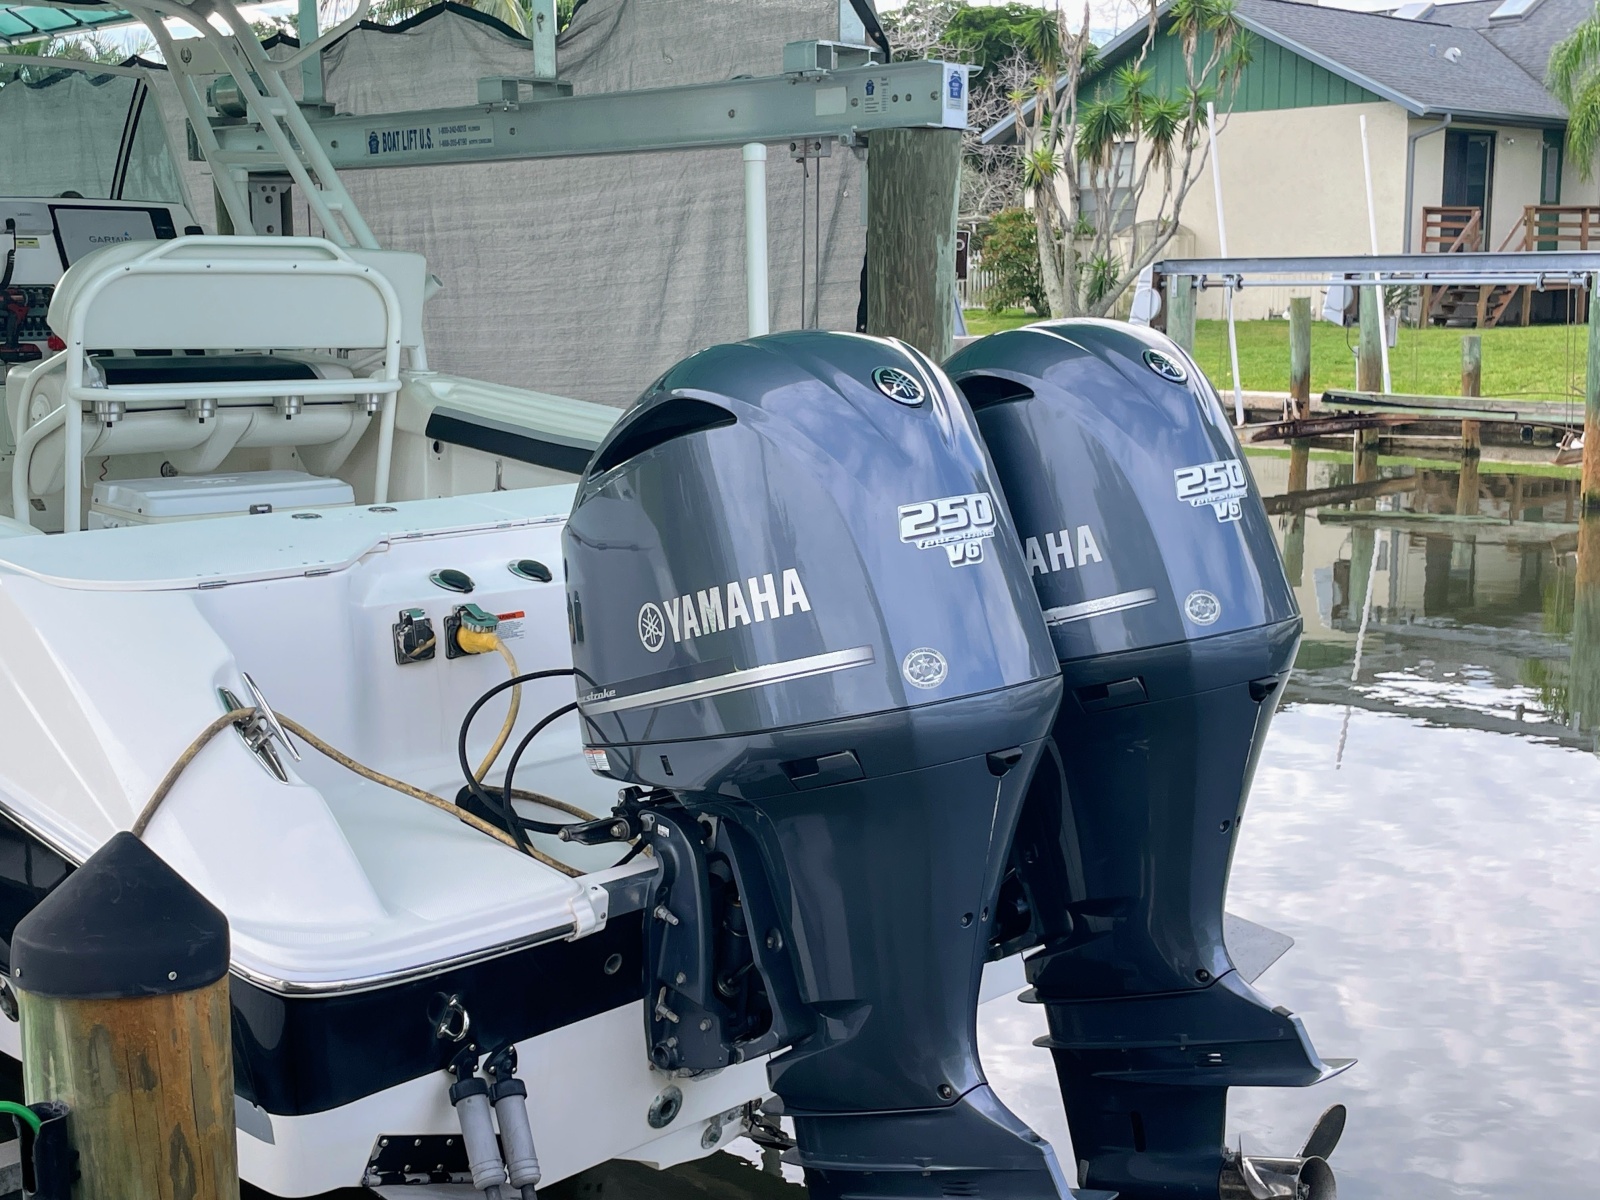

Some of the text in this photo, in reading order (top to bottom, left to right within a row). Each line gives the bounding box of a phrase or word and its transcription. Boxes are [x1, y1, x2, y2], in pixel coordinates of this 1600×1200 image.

[382, 130, 400, 152] BOAT
[402, 129, 418, 151] LIFT
[420, 128, 434, 149] U.S.
[88, 235, 133, 243] GARMIN
[1175, 460, 1247, 499] 250
[899, 494, 994, 540] 250
[1213, 501, 1241, 520] V6
[946, 541, 981, 564] V6
[1025, 524, 1103, 577] AHA
[662, 567, 812, 644] YAMAHA
